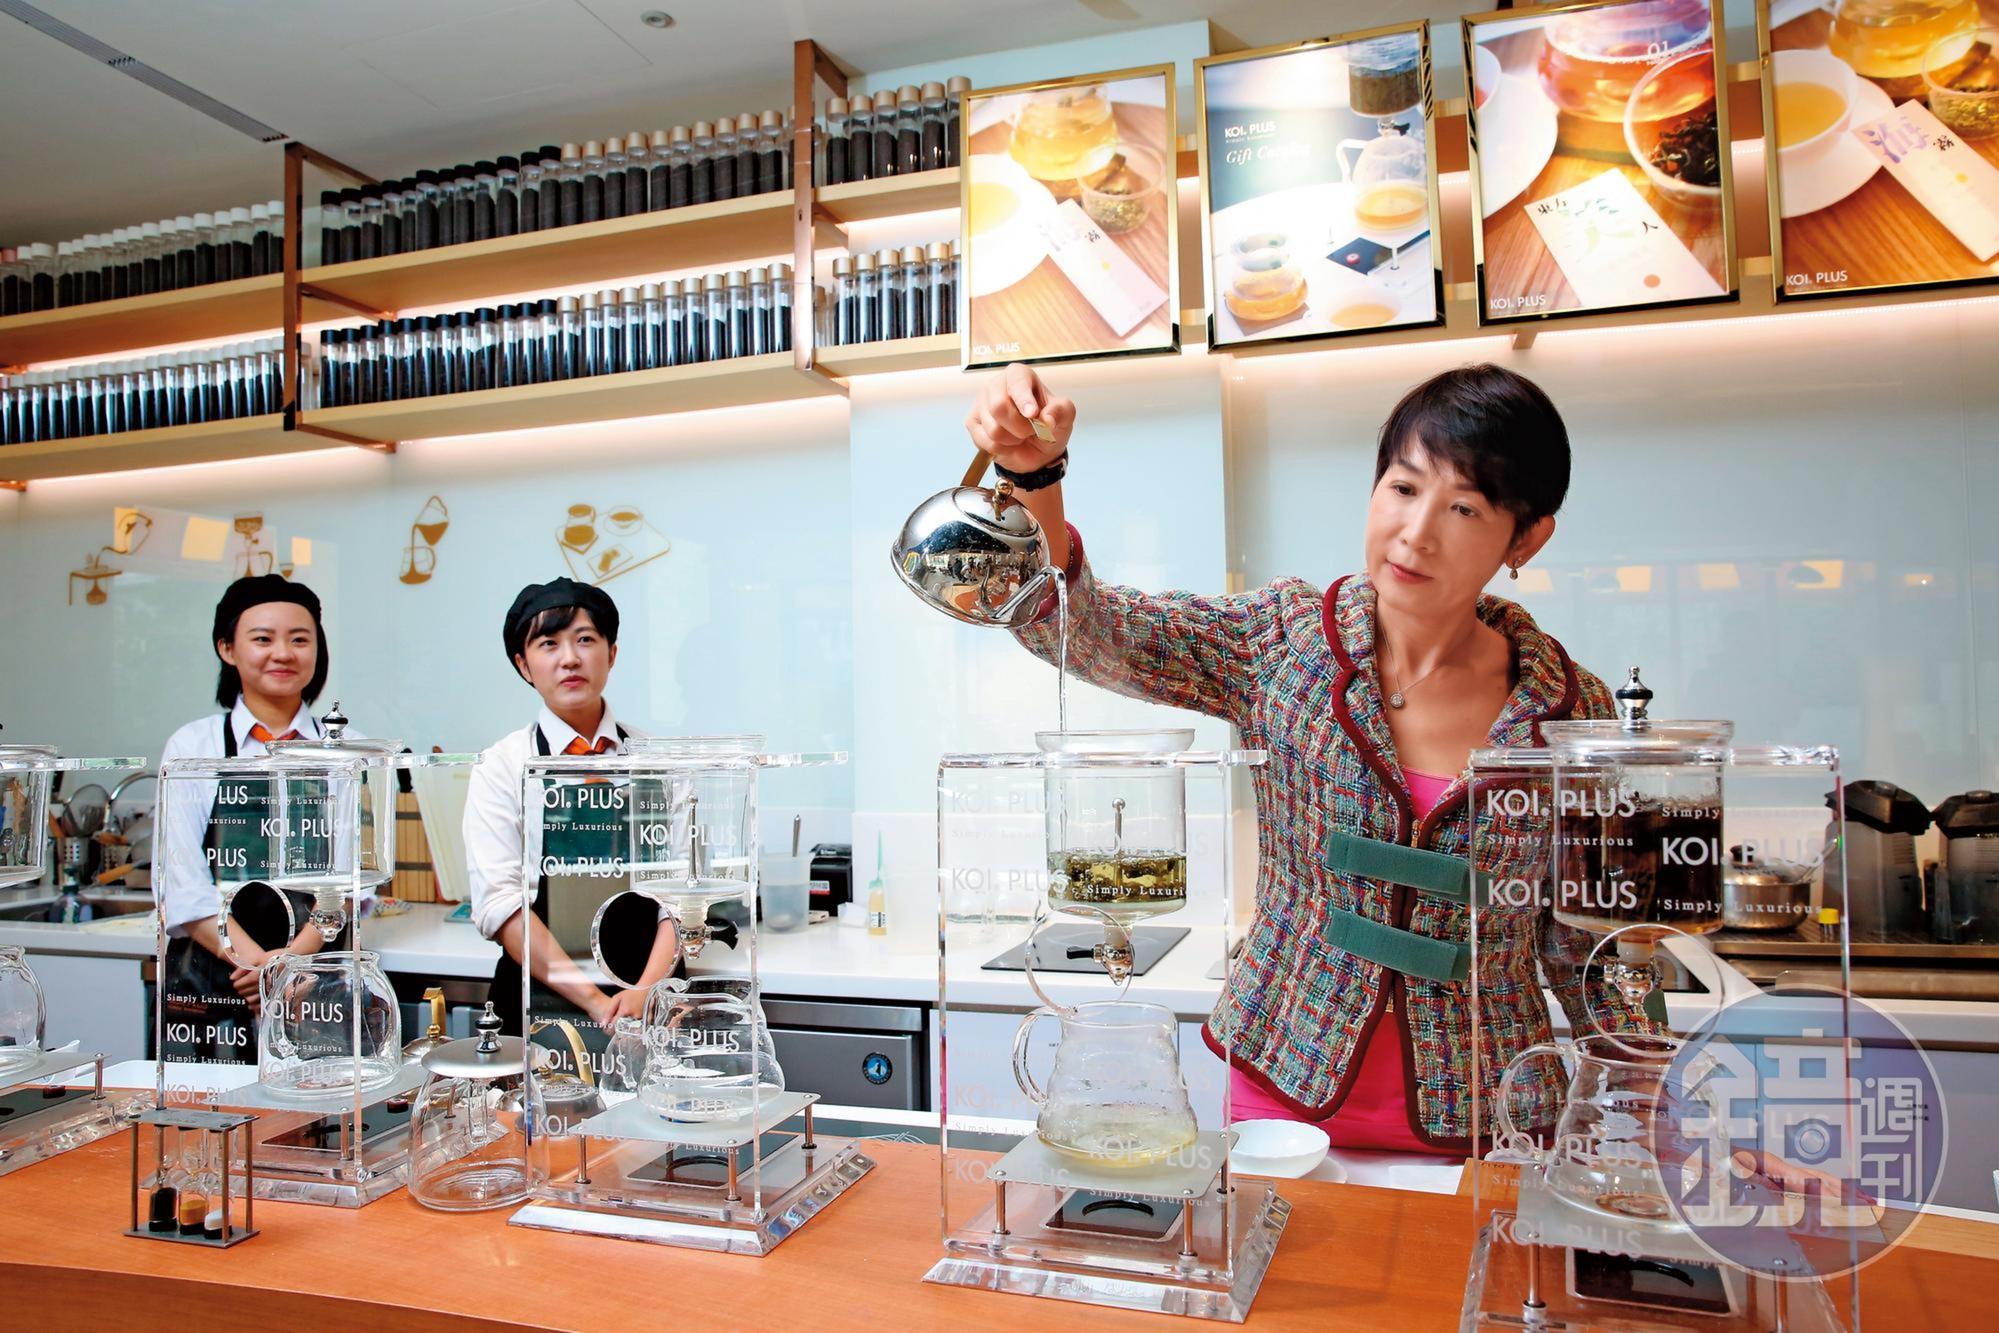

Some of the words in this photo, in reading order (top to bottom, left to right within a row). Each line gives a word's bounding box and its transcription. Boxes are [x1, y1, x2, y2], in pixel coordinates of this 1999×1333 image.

[1249, 120, 1277, 135] PLUS
[1226, 147, 1252, 166] Gift
[1816, 270, 1849, 284] PLUS
[1518, 294, 1547, 308] PLUS
[577, 788, 625, 809] PLUS
[1560, 788, 1637, 818] PLUS
[1661, 806, 1721, 819] Simply
[572, 821, 623, 832] Luxurious
[1551, 836, 1635, 848] Luxurious
[207, 847, 248, 868] PLUS
[1741, 837, 1824, 867] PLUS
[1086, 884, 1133, 897] Simply
[1561, 878, 1639, 910] PLUS
[1663, 898, 1723, 913] Simply
[166, 993, 197, 1004] Simply
[201, 995, 246, 1005] Luxurious
[301, 1001, 344, 1023] PLUS
[206, 1025, 247, 1047] PLUS
[166, 1053, 197, 1064] Simply
[579, 1051, 627, 1075] PLUS
